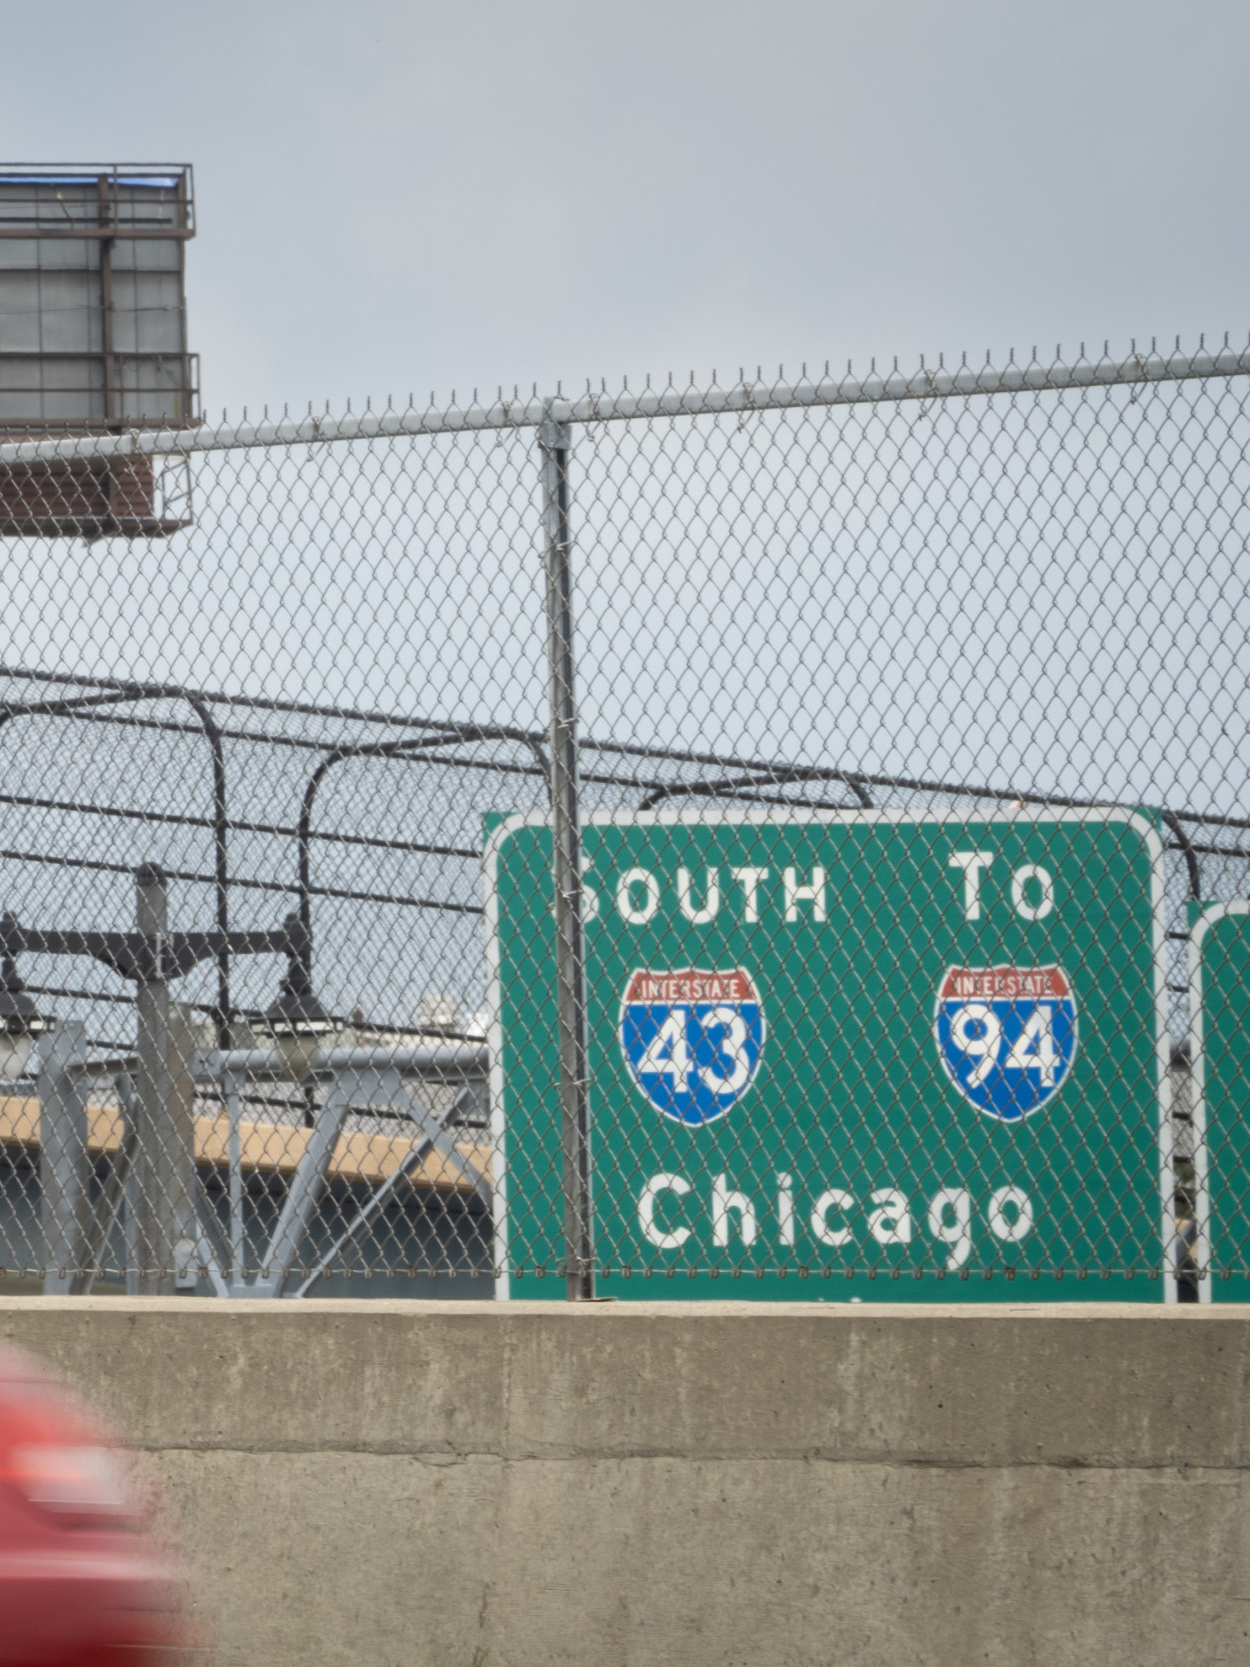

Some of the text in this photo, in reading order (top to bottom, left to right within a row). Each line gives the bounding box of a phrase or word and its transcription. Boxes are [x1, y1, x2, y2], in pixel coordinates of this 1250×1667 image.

[641, 978, 741, 999] INTERSTATE
[637, 1007, 750, 1094] 43
[951, 1004, 1061, 1089] 94
[638, 1172, 1034, 1271] Chicago
